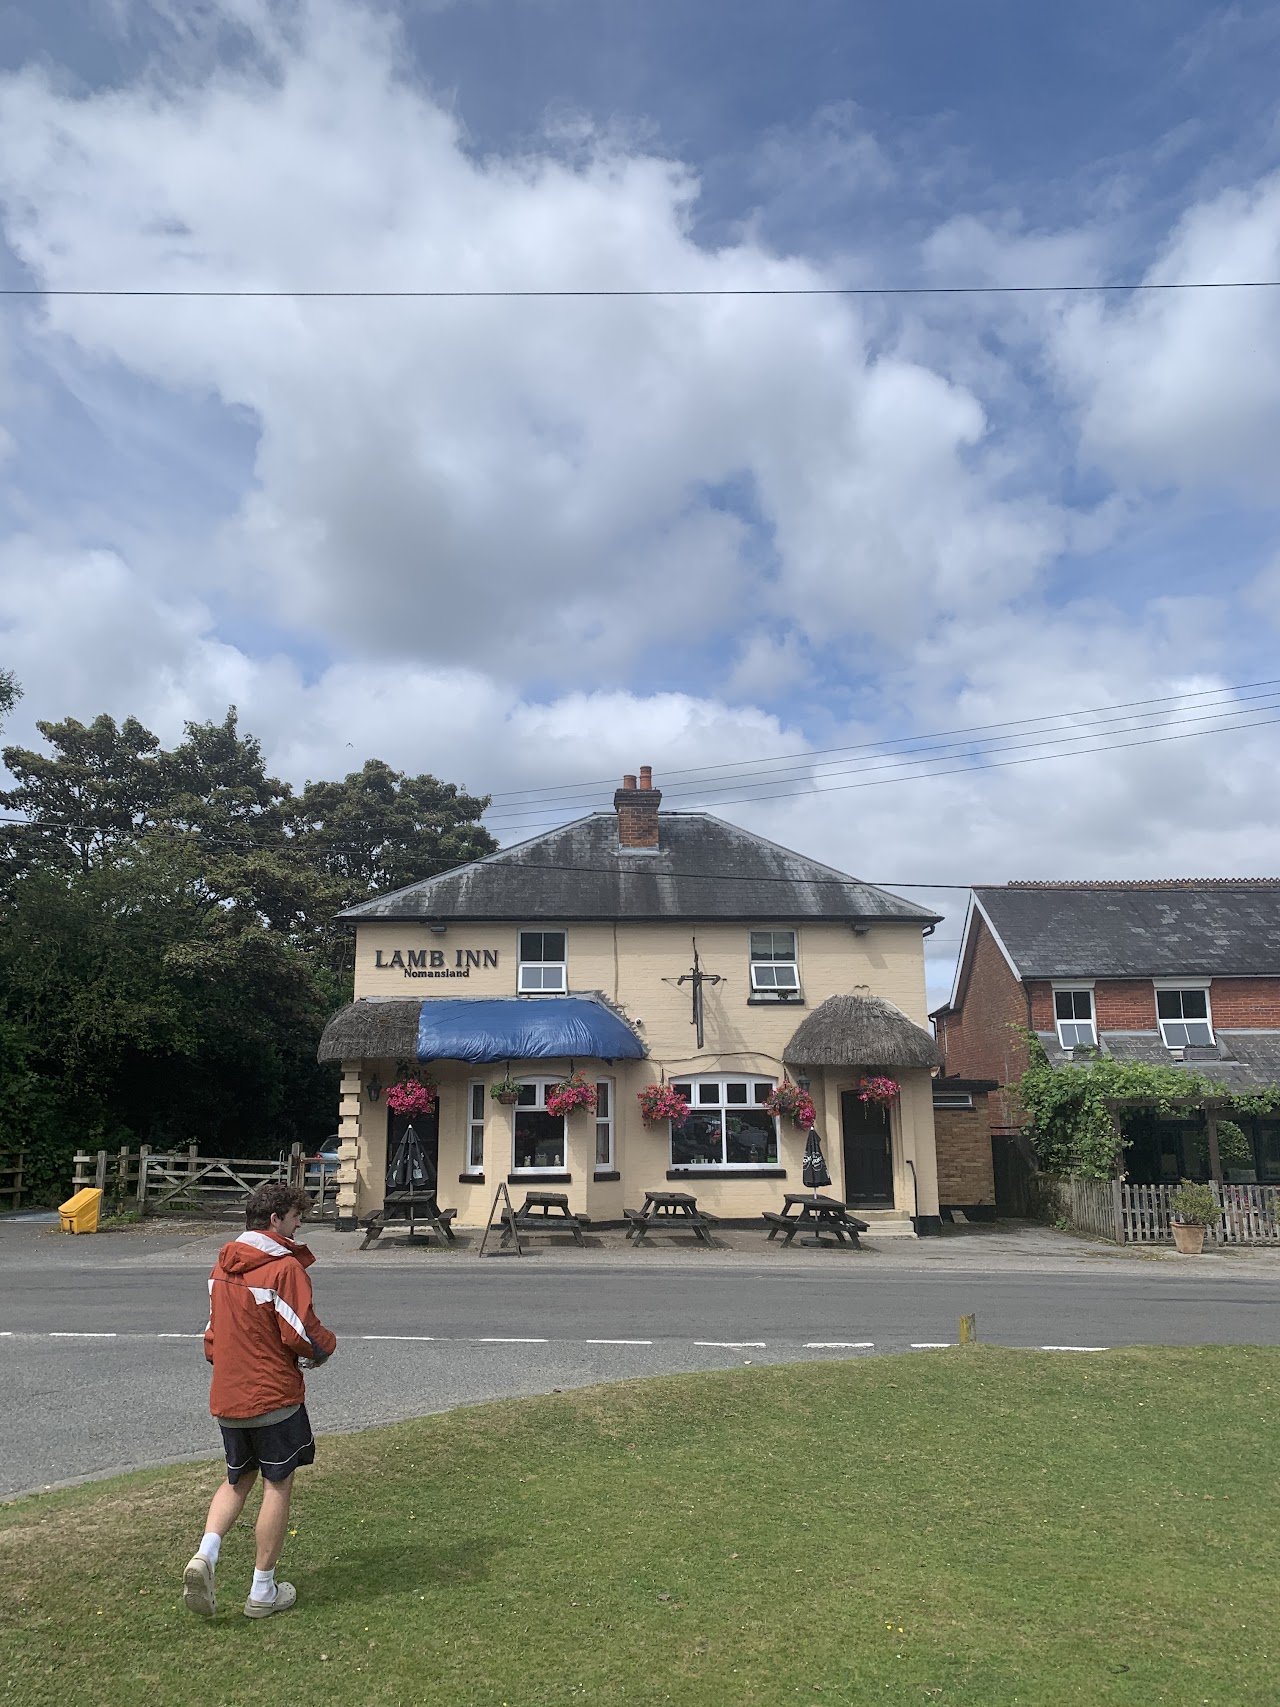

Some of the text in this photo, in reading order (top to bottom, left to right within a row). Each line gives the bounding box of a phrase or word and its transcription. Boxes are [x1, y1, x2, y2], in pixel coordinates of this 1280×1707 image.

[375, 949, 499, 968] LAMB INN
[403, 968, 470, 978] Nomansland
